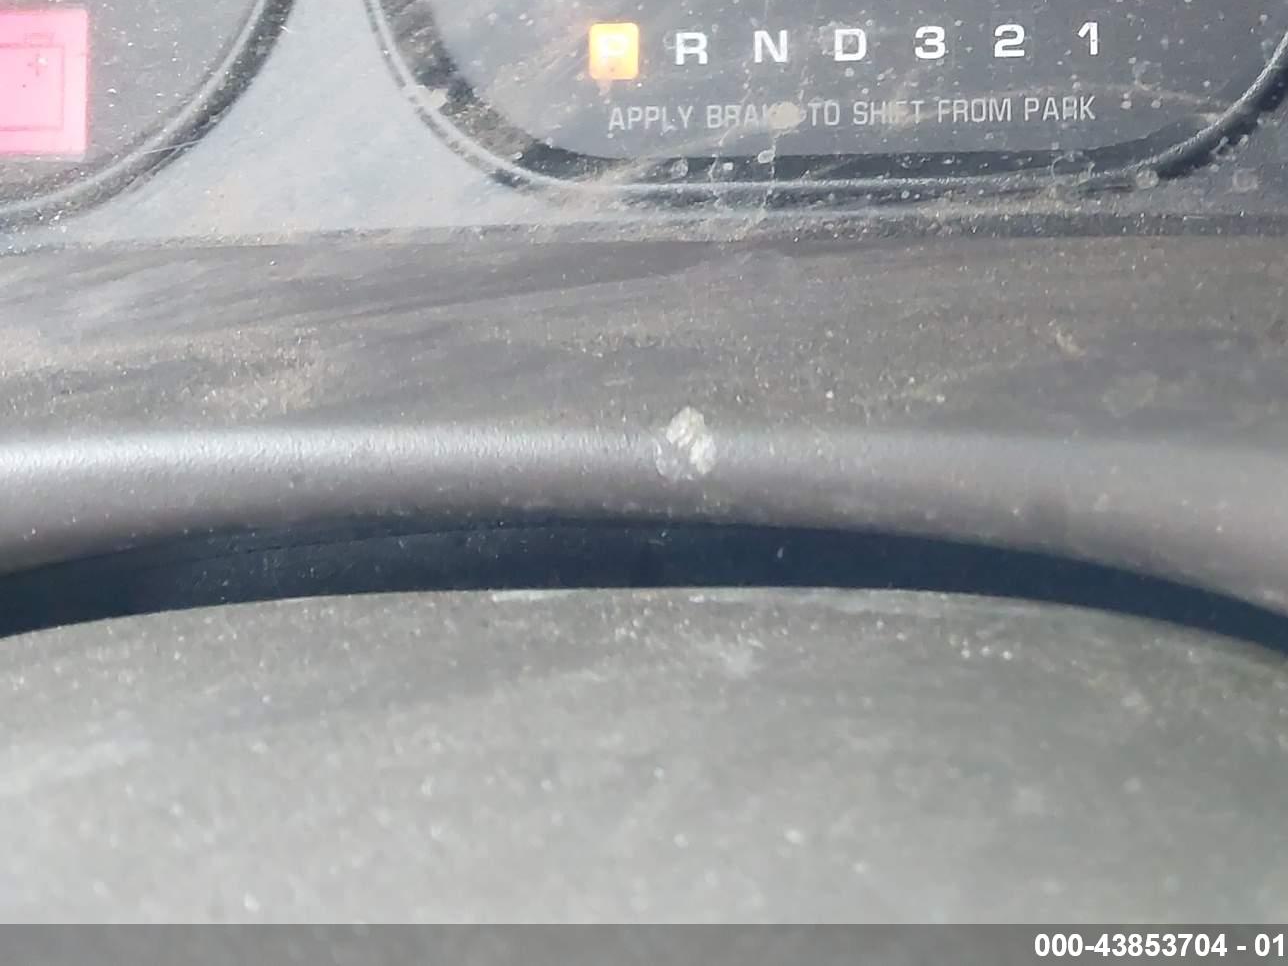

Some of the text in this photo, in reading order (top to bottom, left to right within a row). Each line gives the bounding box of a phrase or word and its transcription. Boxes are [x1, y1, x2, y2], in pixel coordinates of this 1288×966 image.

[675, 32, 708, 65] R
[754, 30, 788, 63] N
[834, 28, 867, 61] D
[915, 25, 946, 59] 3
[994, 23, 1026, 57] 2
[1077, 22, 1099, 55] 1
[608, 105, 694, 131] APPLY
[807, 101, 841, 126] TO
[937, 97, 1012, 123] FROM
[1023, 95, 1096, 121] PARK
